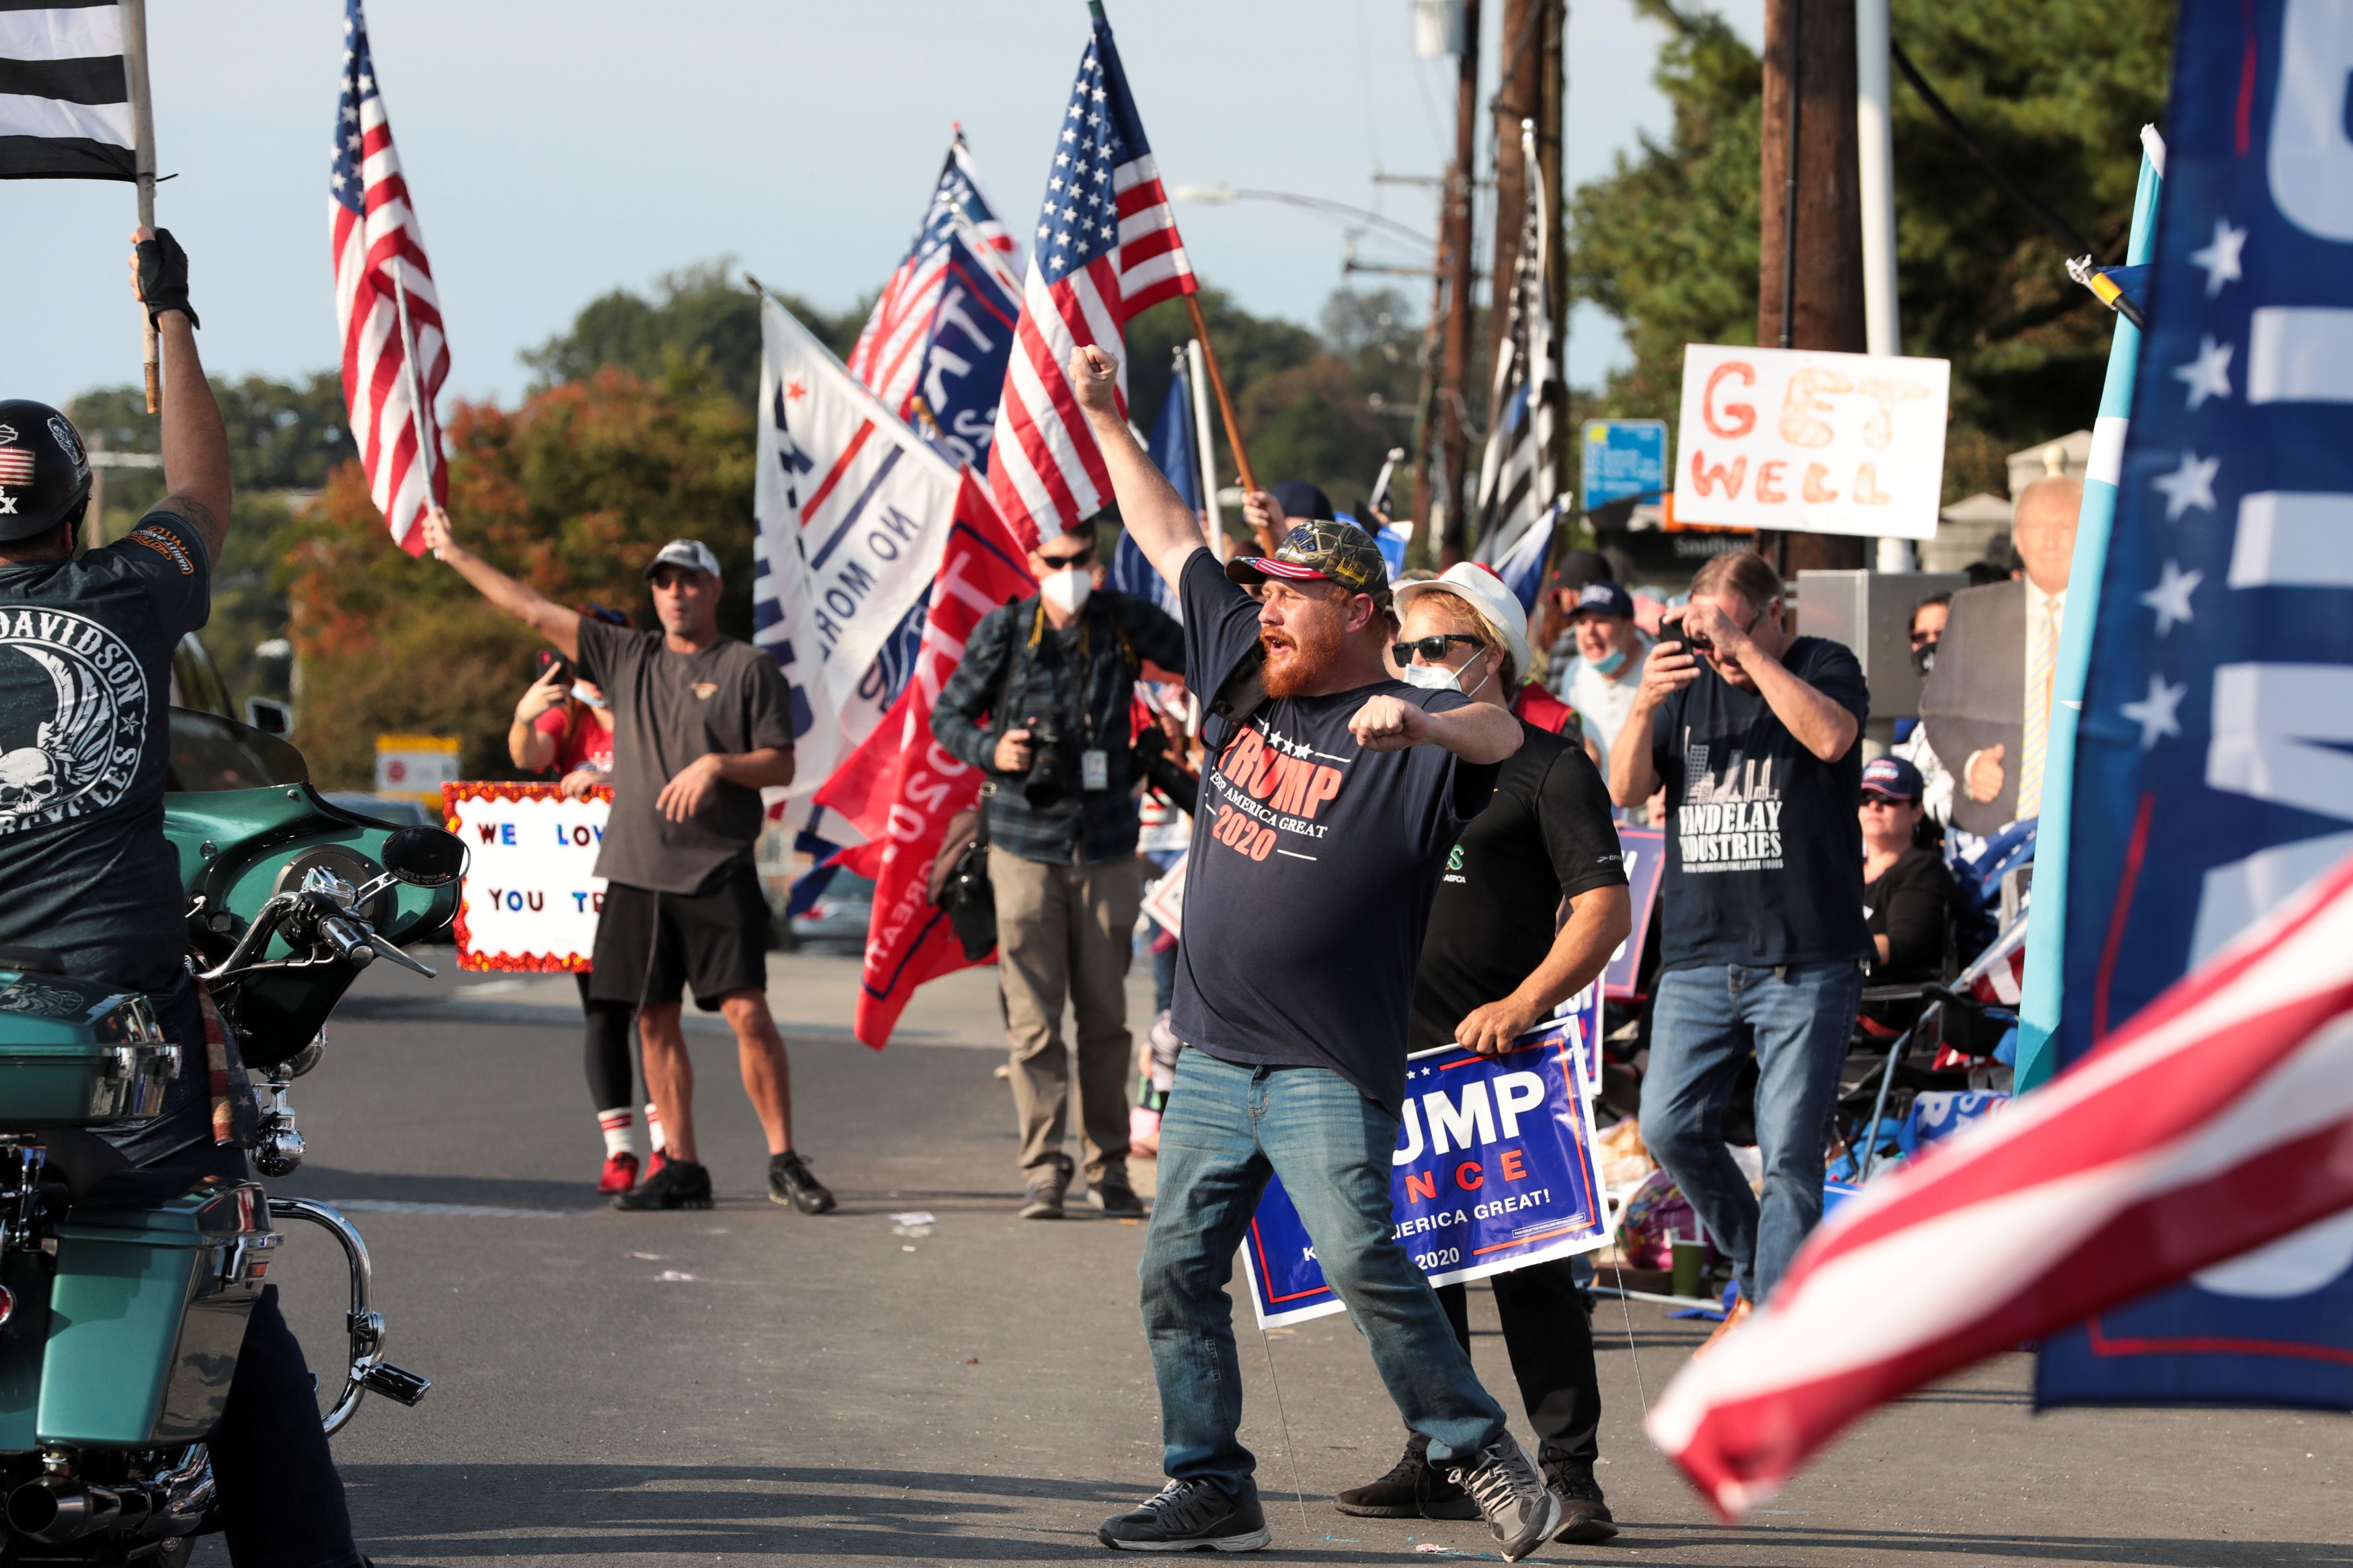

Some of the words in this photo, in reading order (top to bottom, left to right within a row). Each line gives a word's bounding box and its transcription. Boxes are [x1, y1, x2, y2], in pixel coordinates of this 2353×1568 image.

[1703, 361, 1930, 450] GET
[1691, 450, 1890, 504] WELL
[1212, 804, 1277, 862] 2020
[1224, 787, 1277, 826] AMERICA
[1279, 817, 1328, 838] GREAT
[479, 824, 516, 845] WE
[489, 889, 543, 911] YOU
[1474, 1189, 1550, 1221] GREAT!
[1414, 1246, 1460, 1270] 2020
